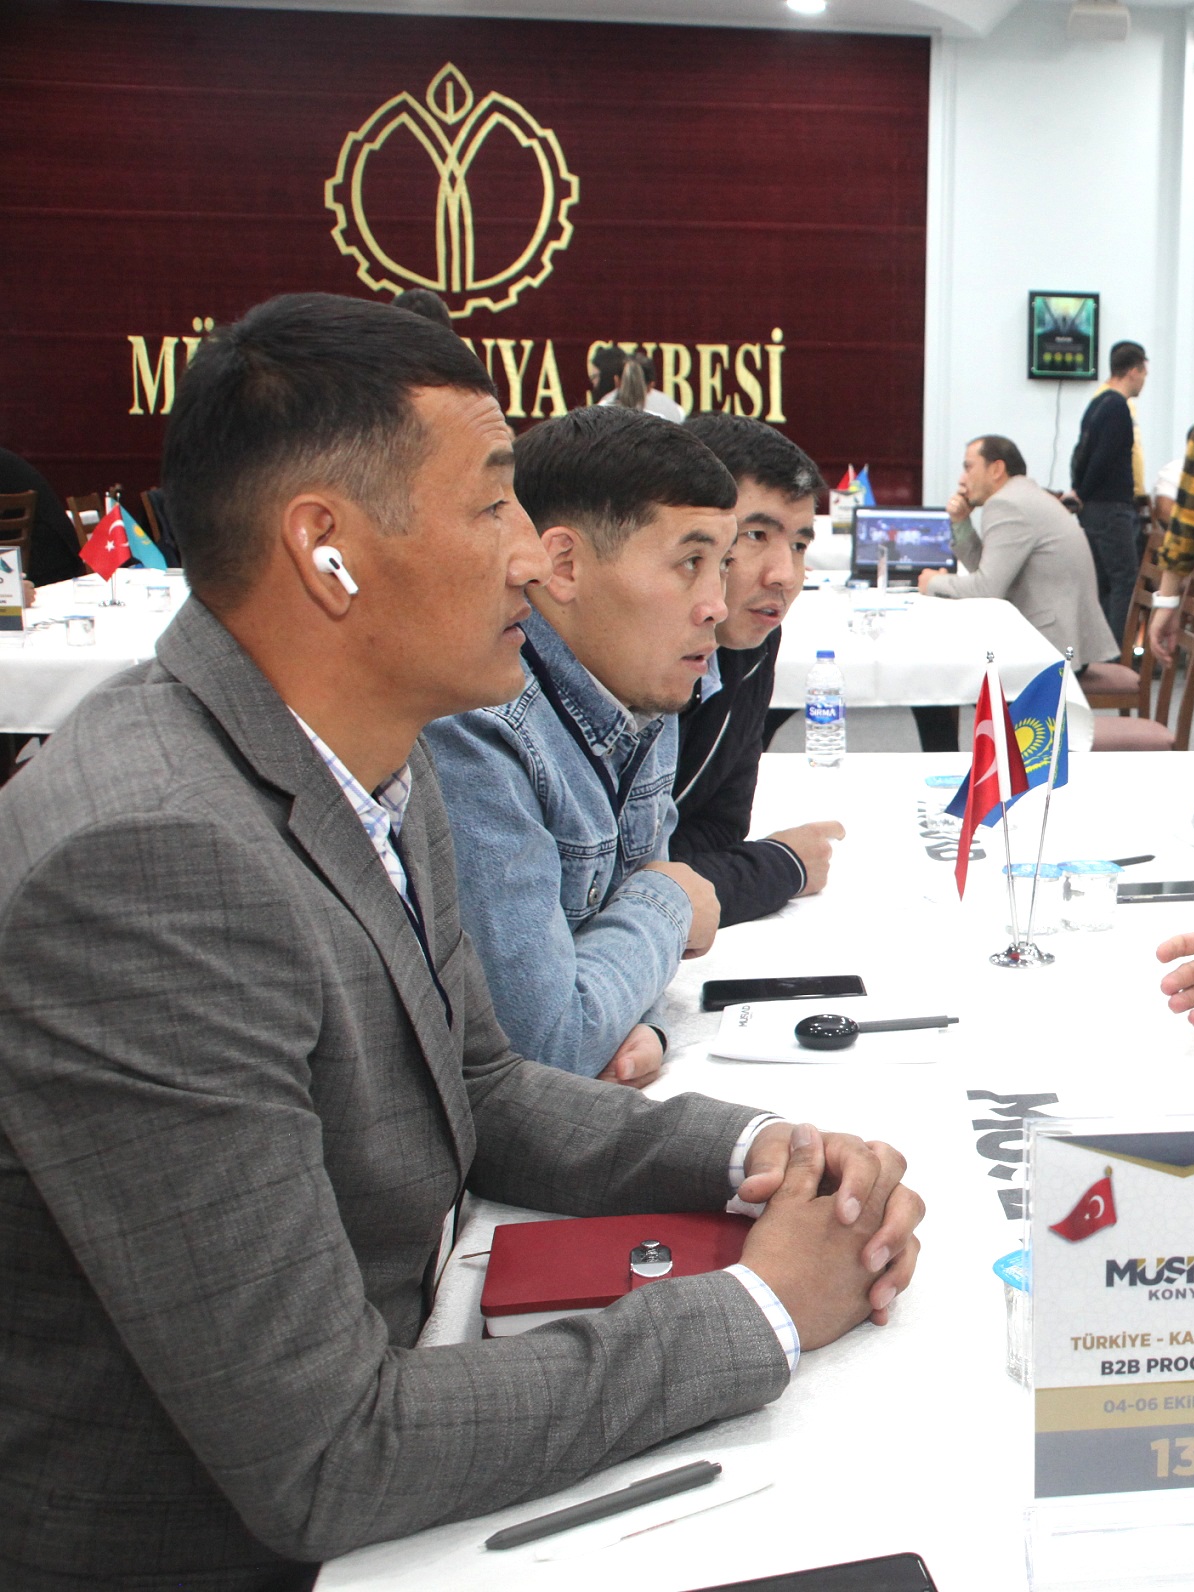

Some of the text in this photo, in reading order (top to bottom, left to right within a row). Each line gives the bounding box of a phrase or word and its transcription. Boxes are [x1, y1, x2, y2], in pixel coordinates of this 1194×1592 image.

[1070, 1331, 1151, 1351] TÜRKİYE
[1101, 1358, 1140, 1376] B2B
[1103, 1397, 1158, 1414] 04-06
